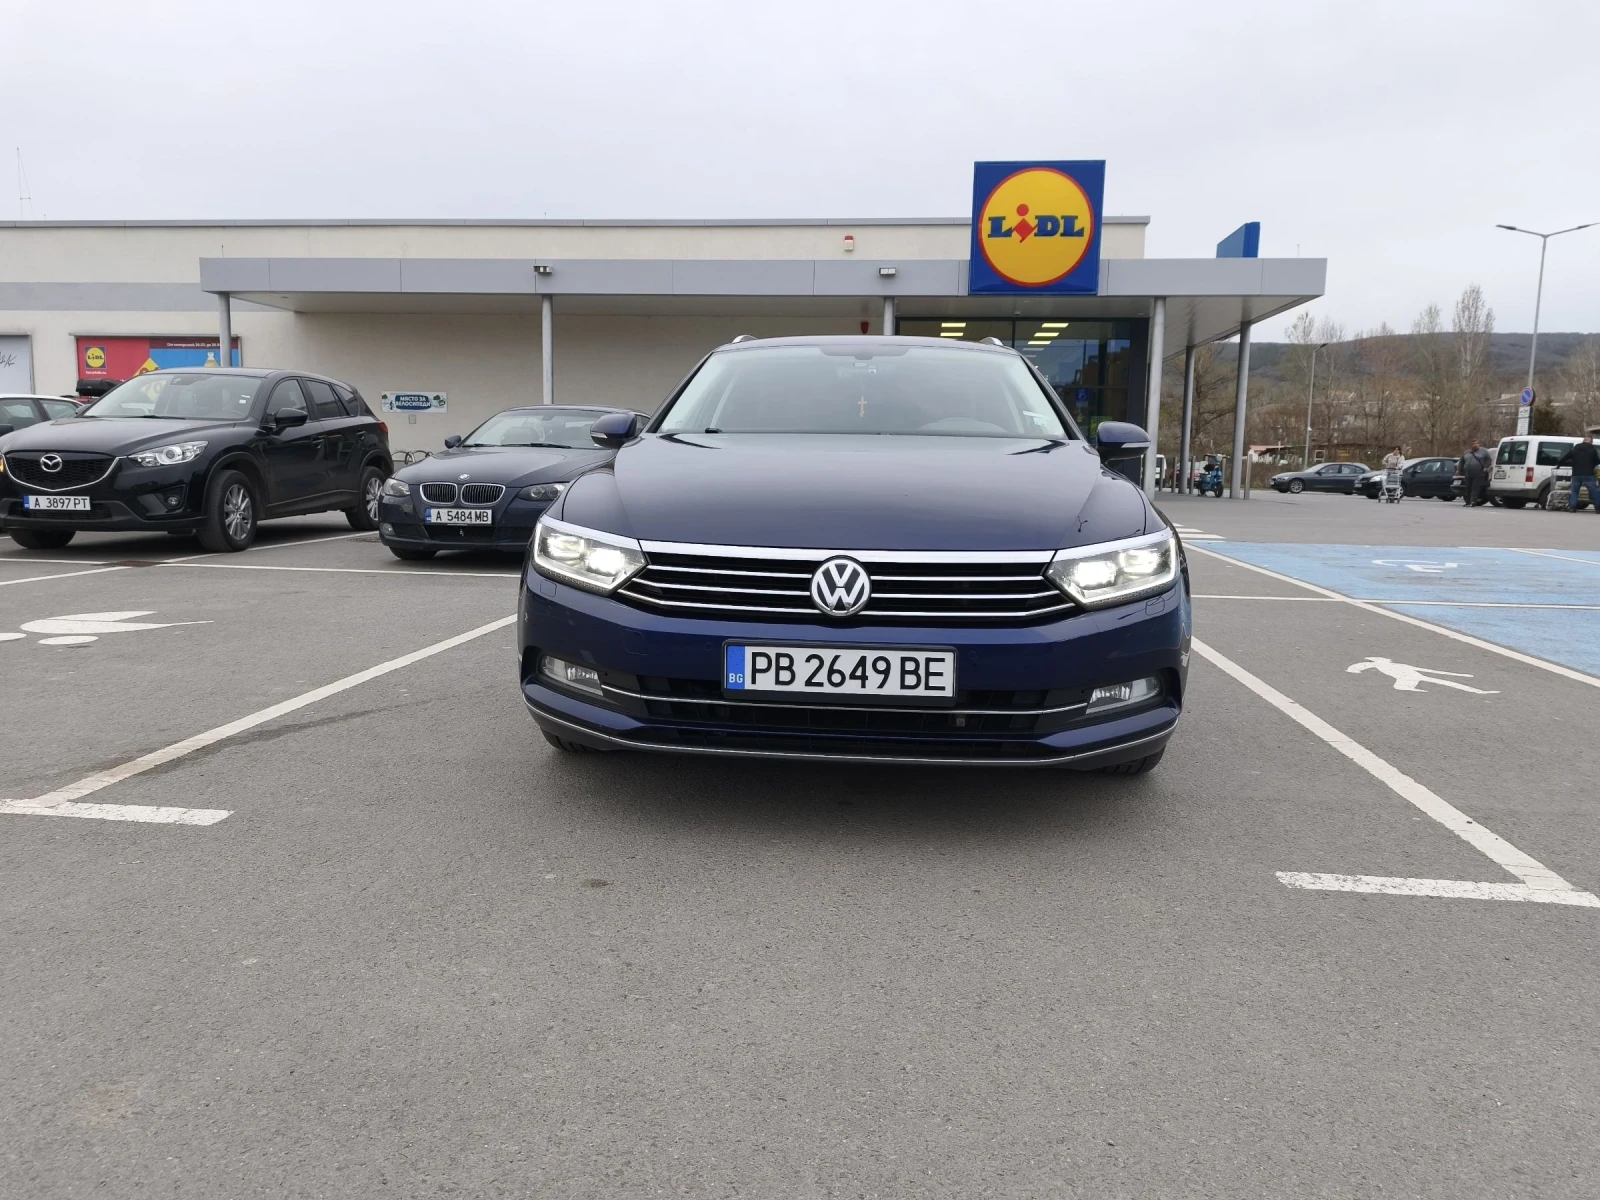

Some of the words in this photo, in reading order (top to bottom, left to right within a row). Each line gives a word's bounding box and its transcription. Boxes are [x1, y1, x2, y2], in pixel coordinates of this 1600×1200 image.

[34, 497, 41, 508] A
[46, 497, 71, 509] 3897
[73, 497, 88, 509] PT
[435, 510, 442, 522] A
[447, 510, 473, 522] 5484
[474, 510, 489, 522] MB
[750, 651, 796, 686] PB
[804, 653, 892, 689] 2649
[899, 656, 946, 691] BE
[728, 672, 744, 684] BG
